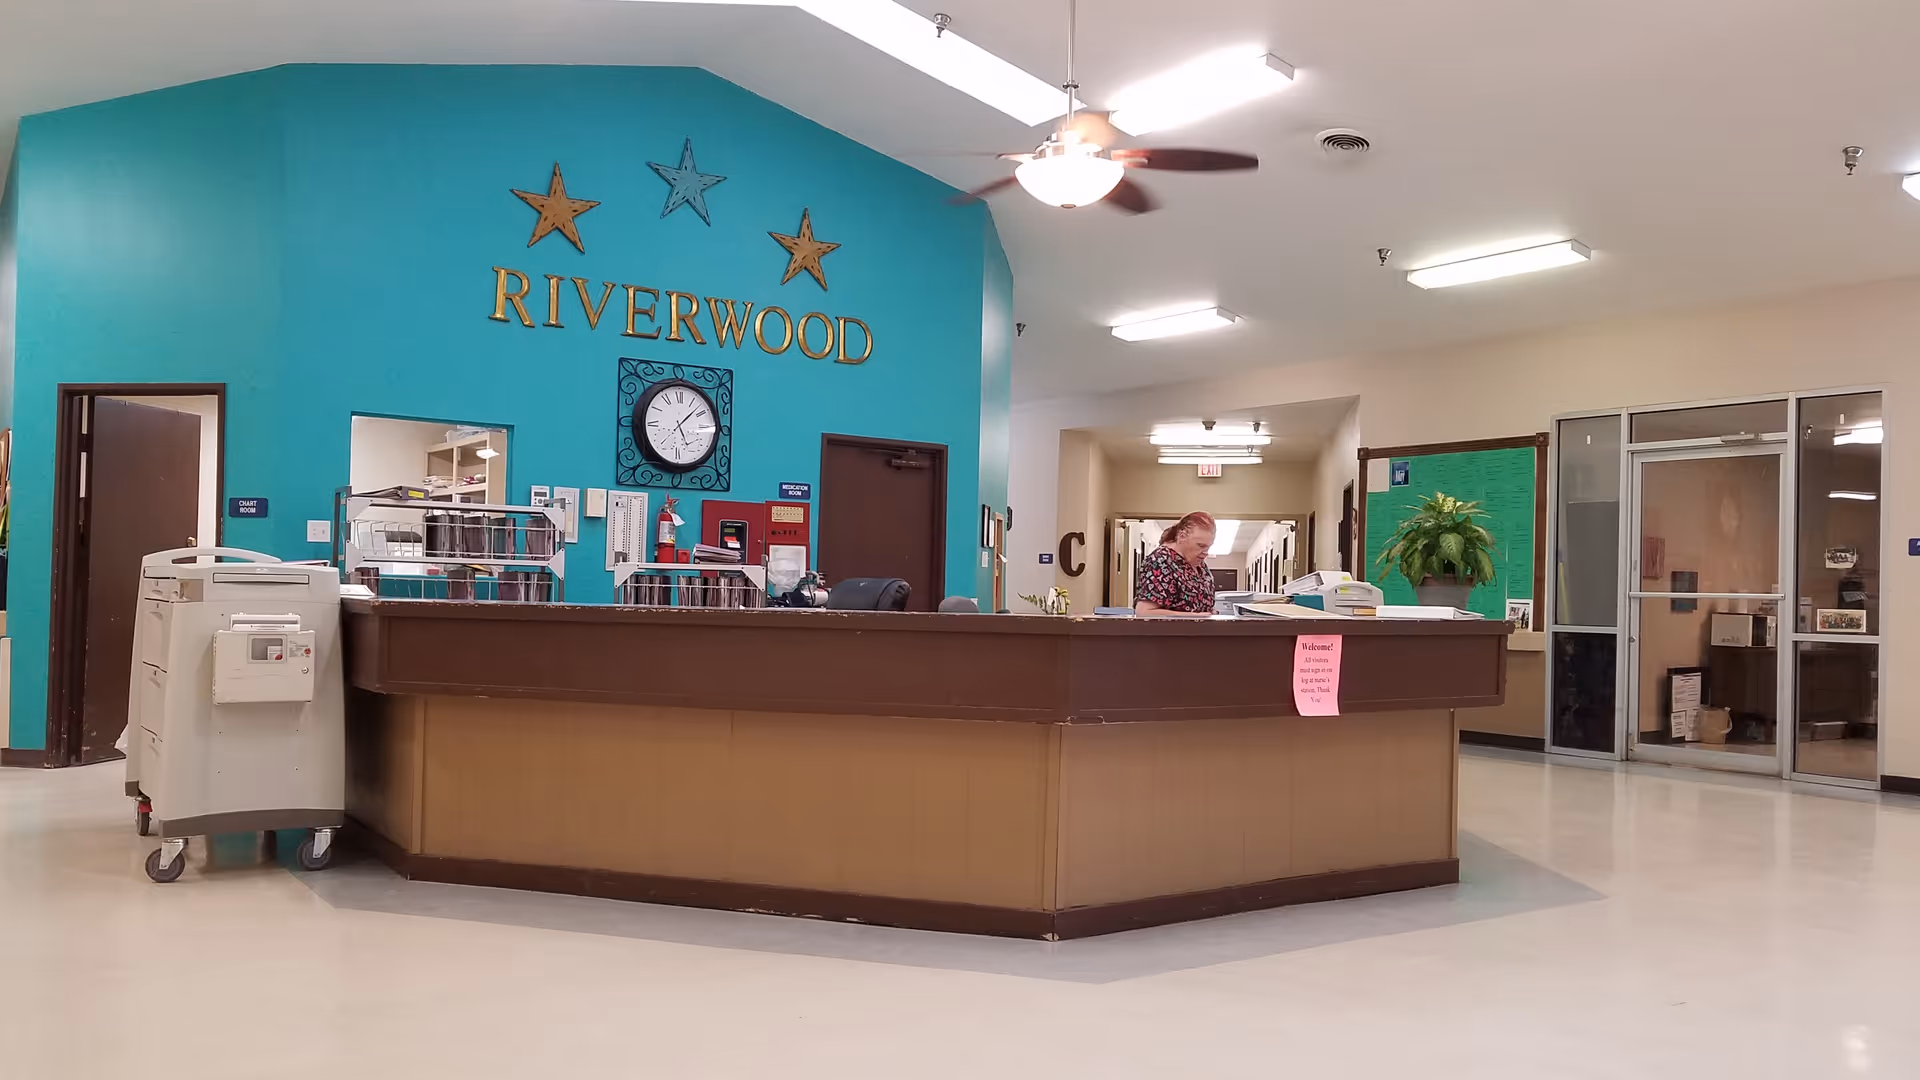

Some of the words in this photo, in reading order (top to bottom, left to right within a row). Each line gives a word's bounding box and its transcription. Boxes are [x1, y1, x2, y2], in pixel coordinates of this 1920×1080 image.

[488, 265, 874, 365] RIVERWOOD
[1059, 531, 1086, 577] C
[1302, 642, 1334, 651] Welcome!
